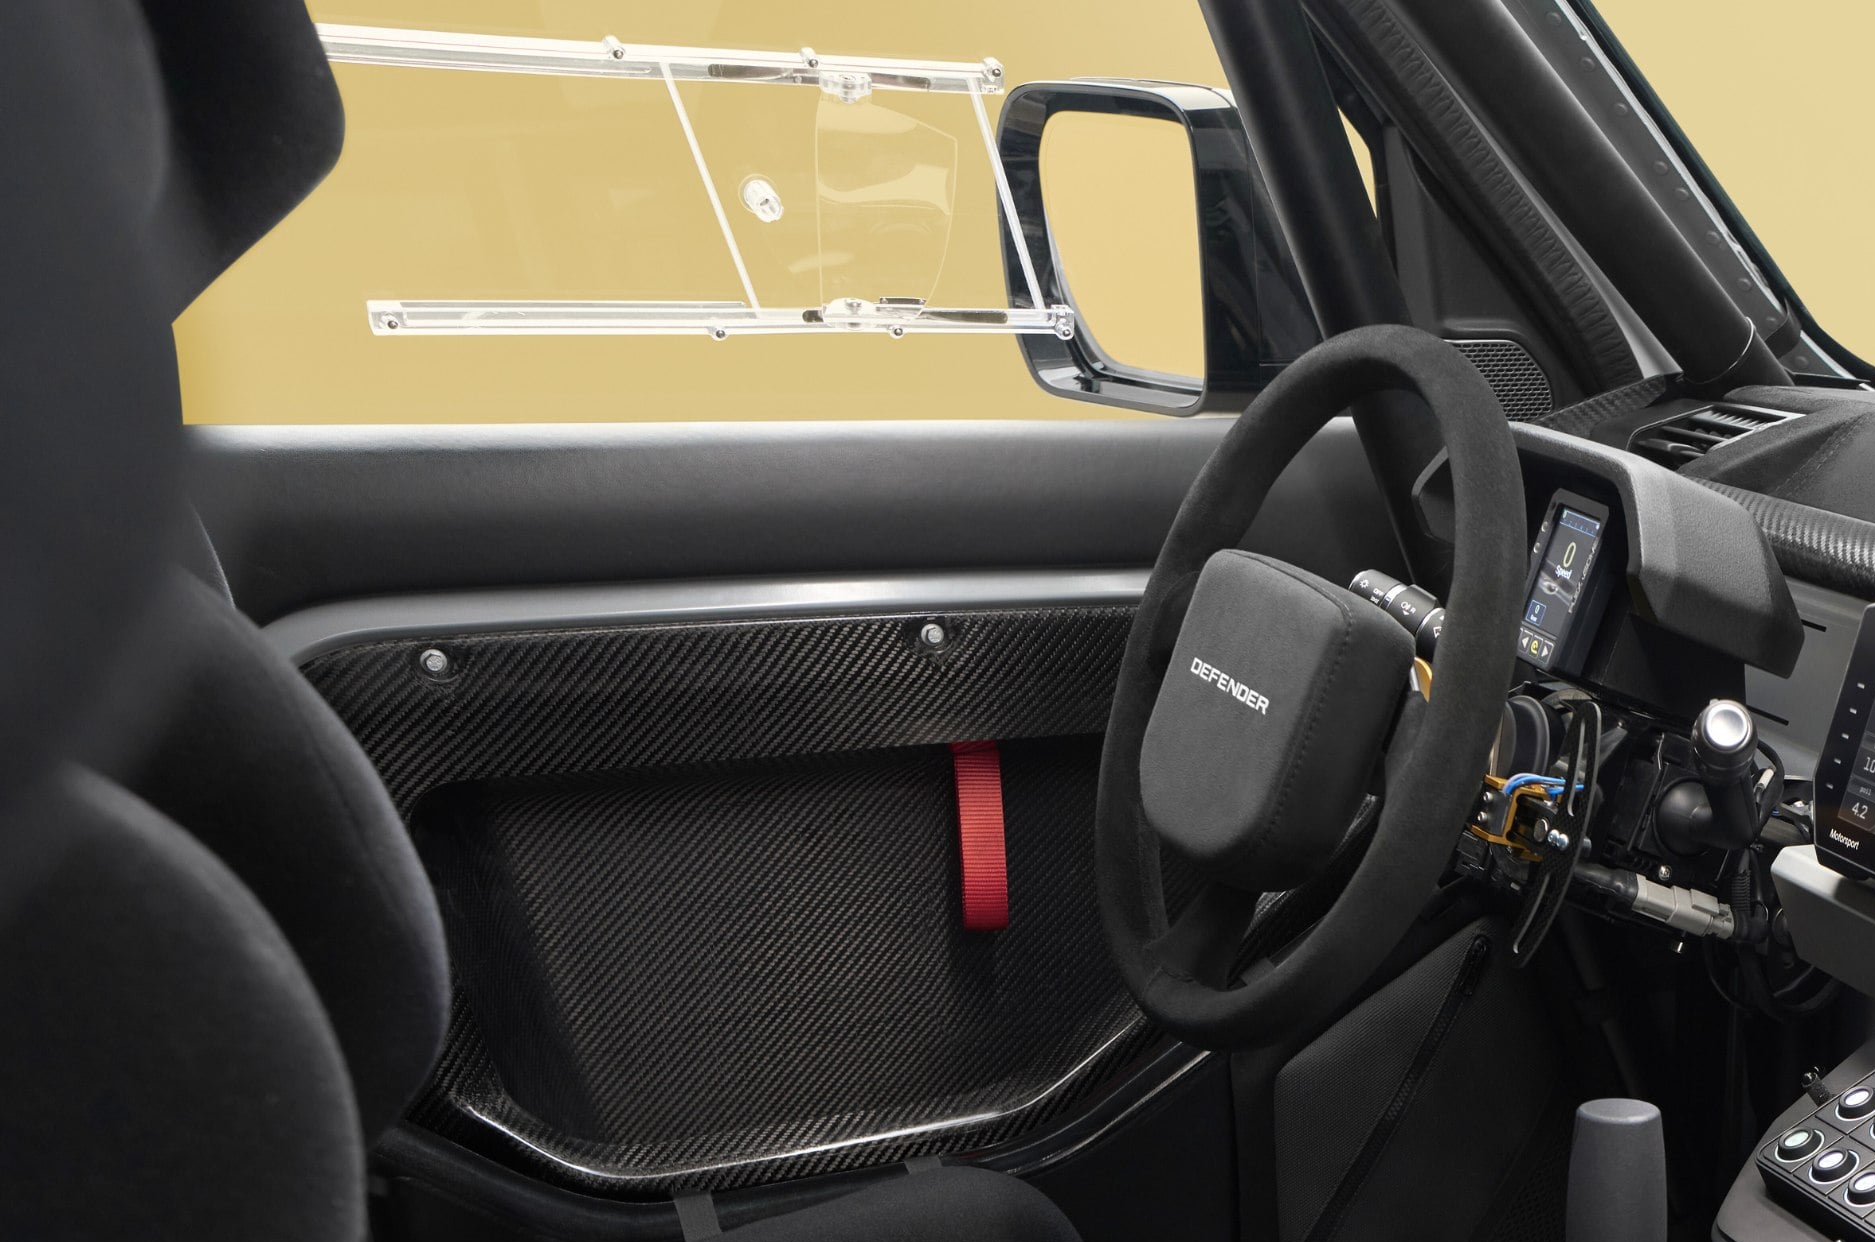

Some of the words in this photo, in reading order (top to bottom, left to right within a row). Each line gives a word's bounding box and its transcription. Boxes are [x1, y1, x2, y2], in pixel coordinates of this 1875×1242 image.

[1563, 542, 1576, 567] 0
[1555, 565, 1573, 580] Speed
[1190, 657, 1270, 715] DEFENDER
[1852, 802, 1868, 819] 4.2
[1829, 828, 1860, 850] Motorsport
